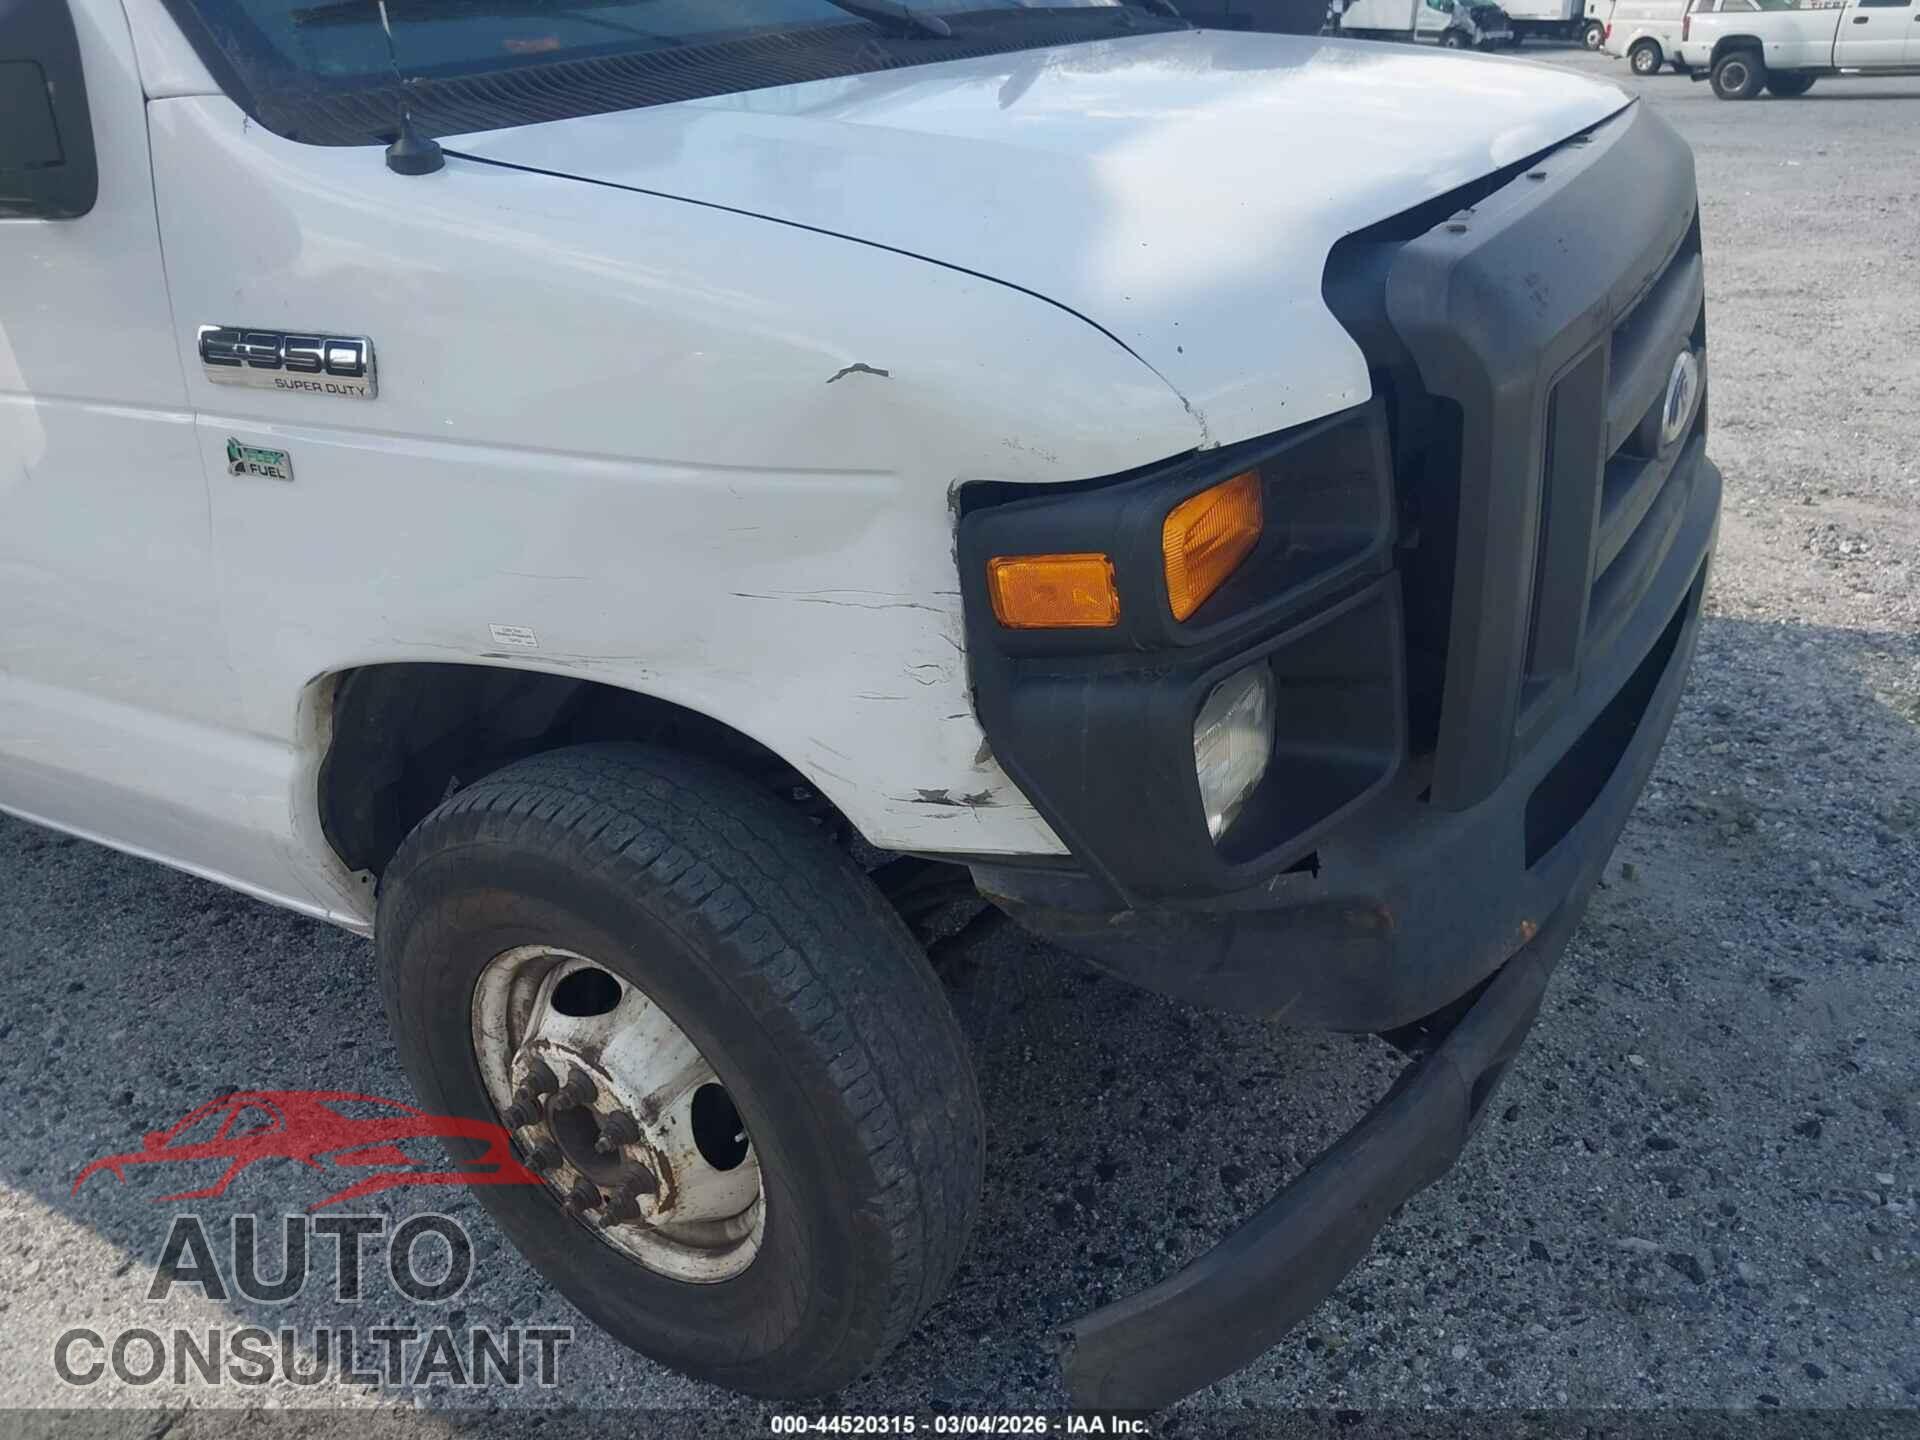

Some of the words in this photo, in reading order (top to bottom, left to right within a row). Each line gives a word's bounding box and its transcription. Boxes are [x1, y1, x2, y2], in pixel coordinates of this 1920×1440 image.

[201, 328, 367, 377] E-350
[275, 378, 323, 392] SUPER
[326, 383, 366, 397] DUTY
[249, 463, 287, 479] FUEL
